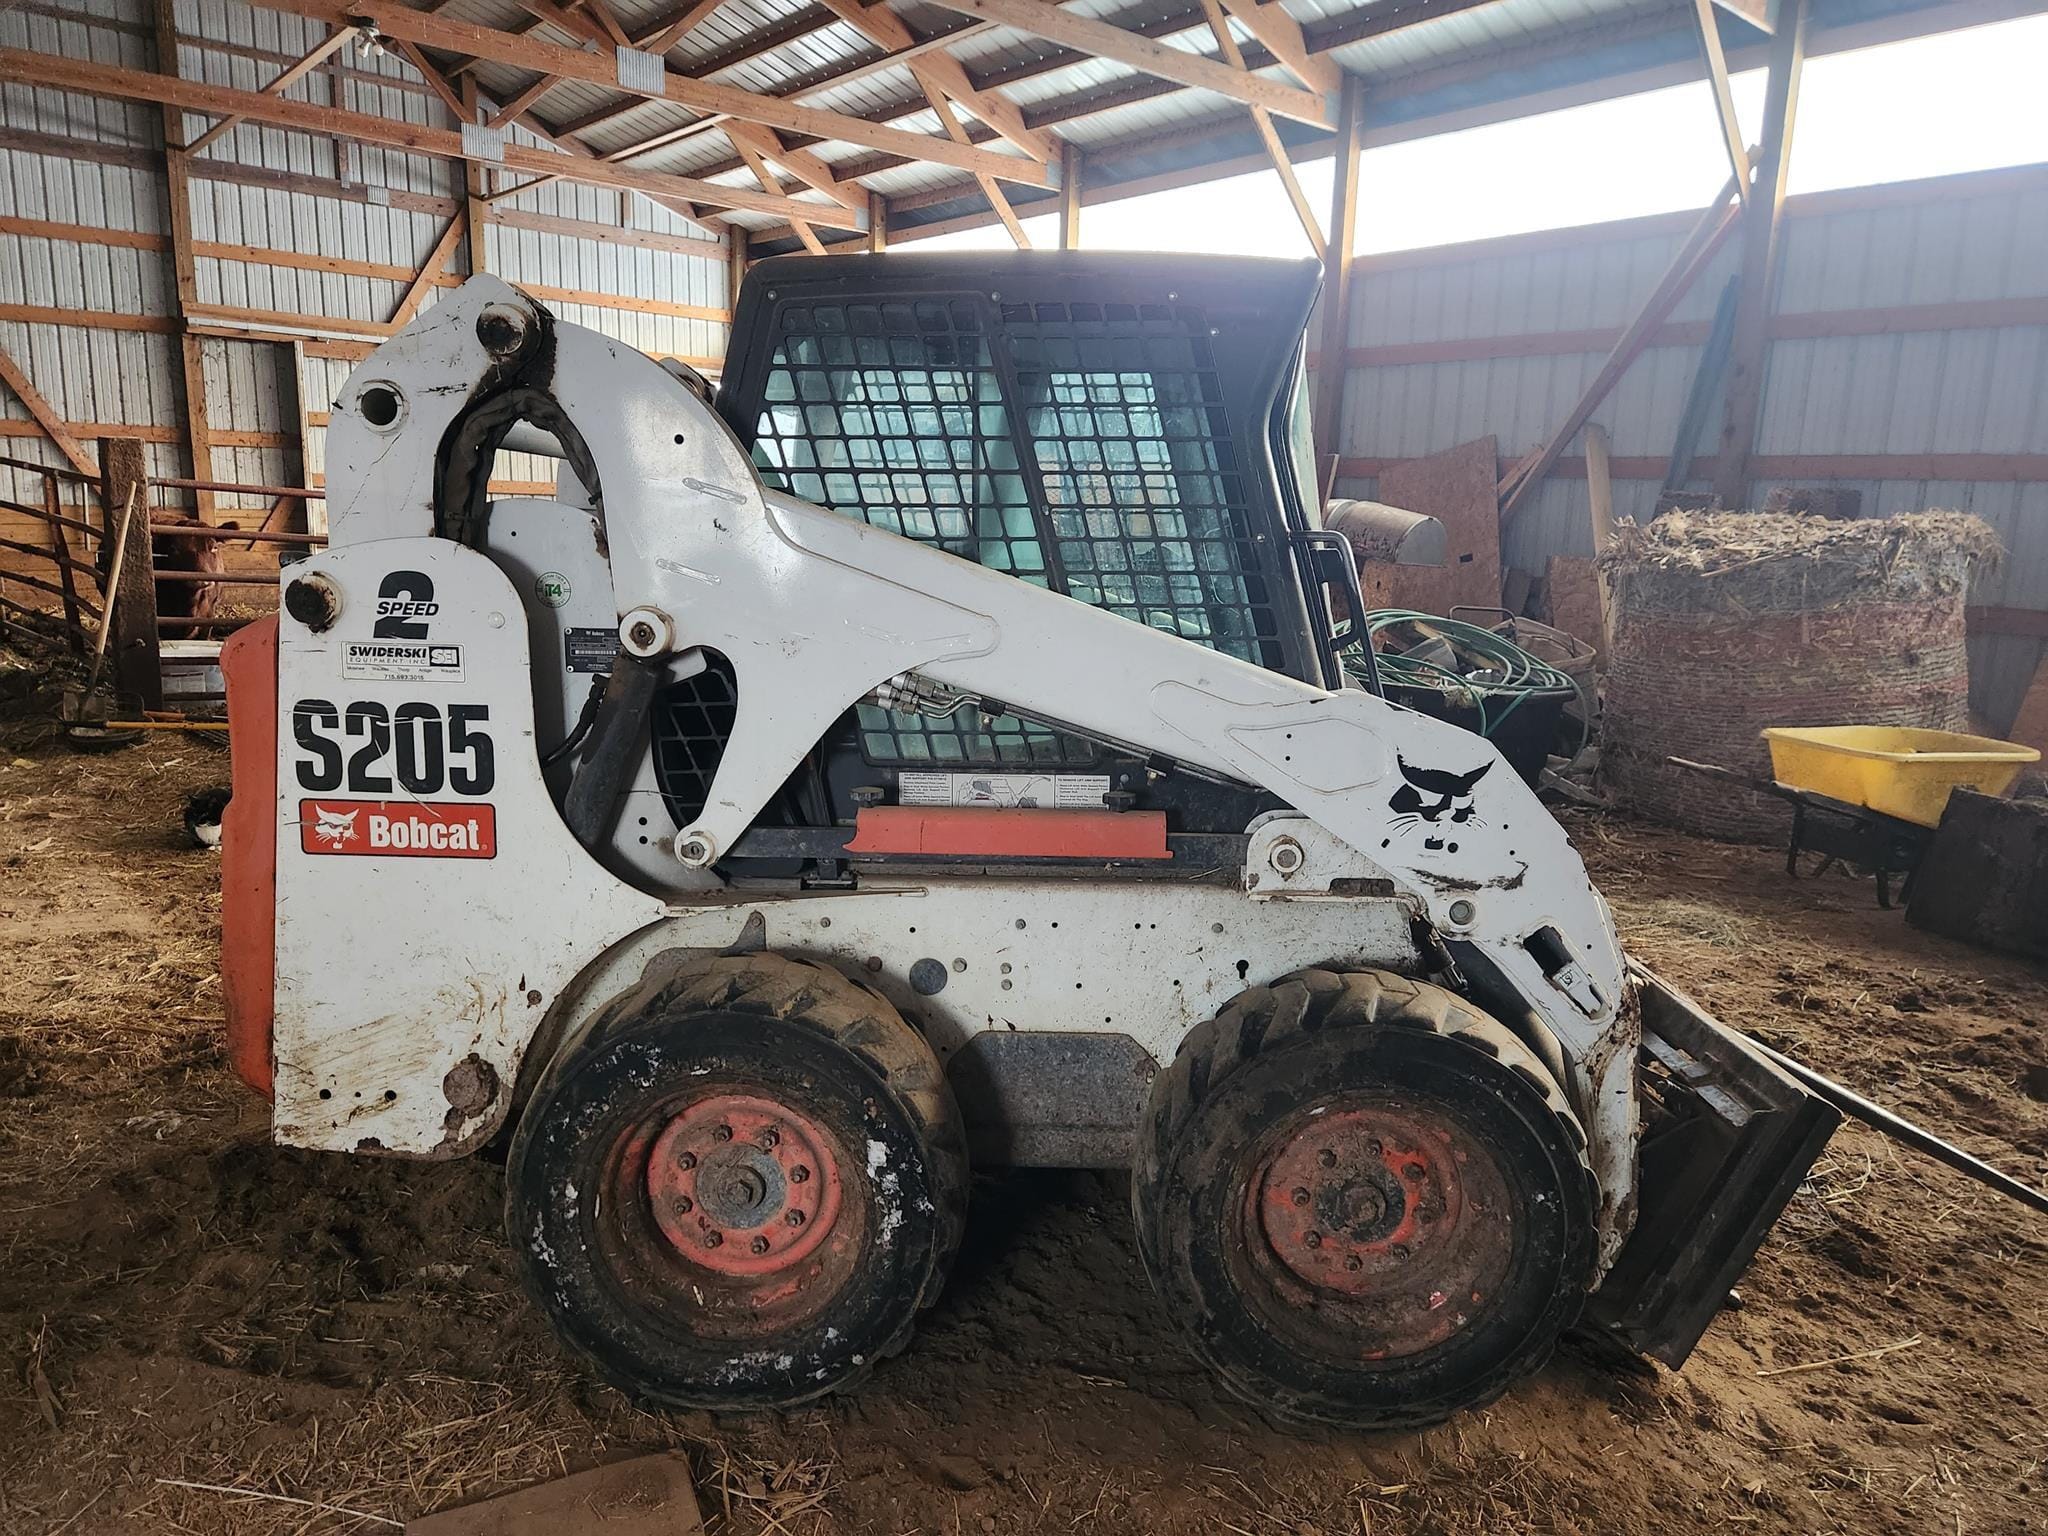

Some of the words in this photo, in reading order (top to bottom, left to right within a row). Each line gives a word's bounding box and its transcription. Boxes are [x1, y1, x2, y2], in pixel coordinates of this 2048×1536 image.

[373, 570, 434, 639] 2
[376, 601, 439, 617] SPEED
[349, 646, 427, 658] SWIDERSKI
[293, 699, 495, 796] S205
[368, 815, 480, 850] Bobcat
